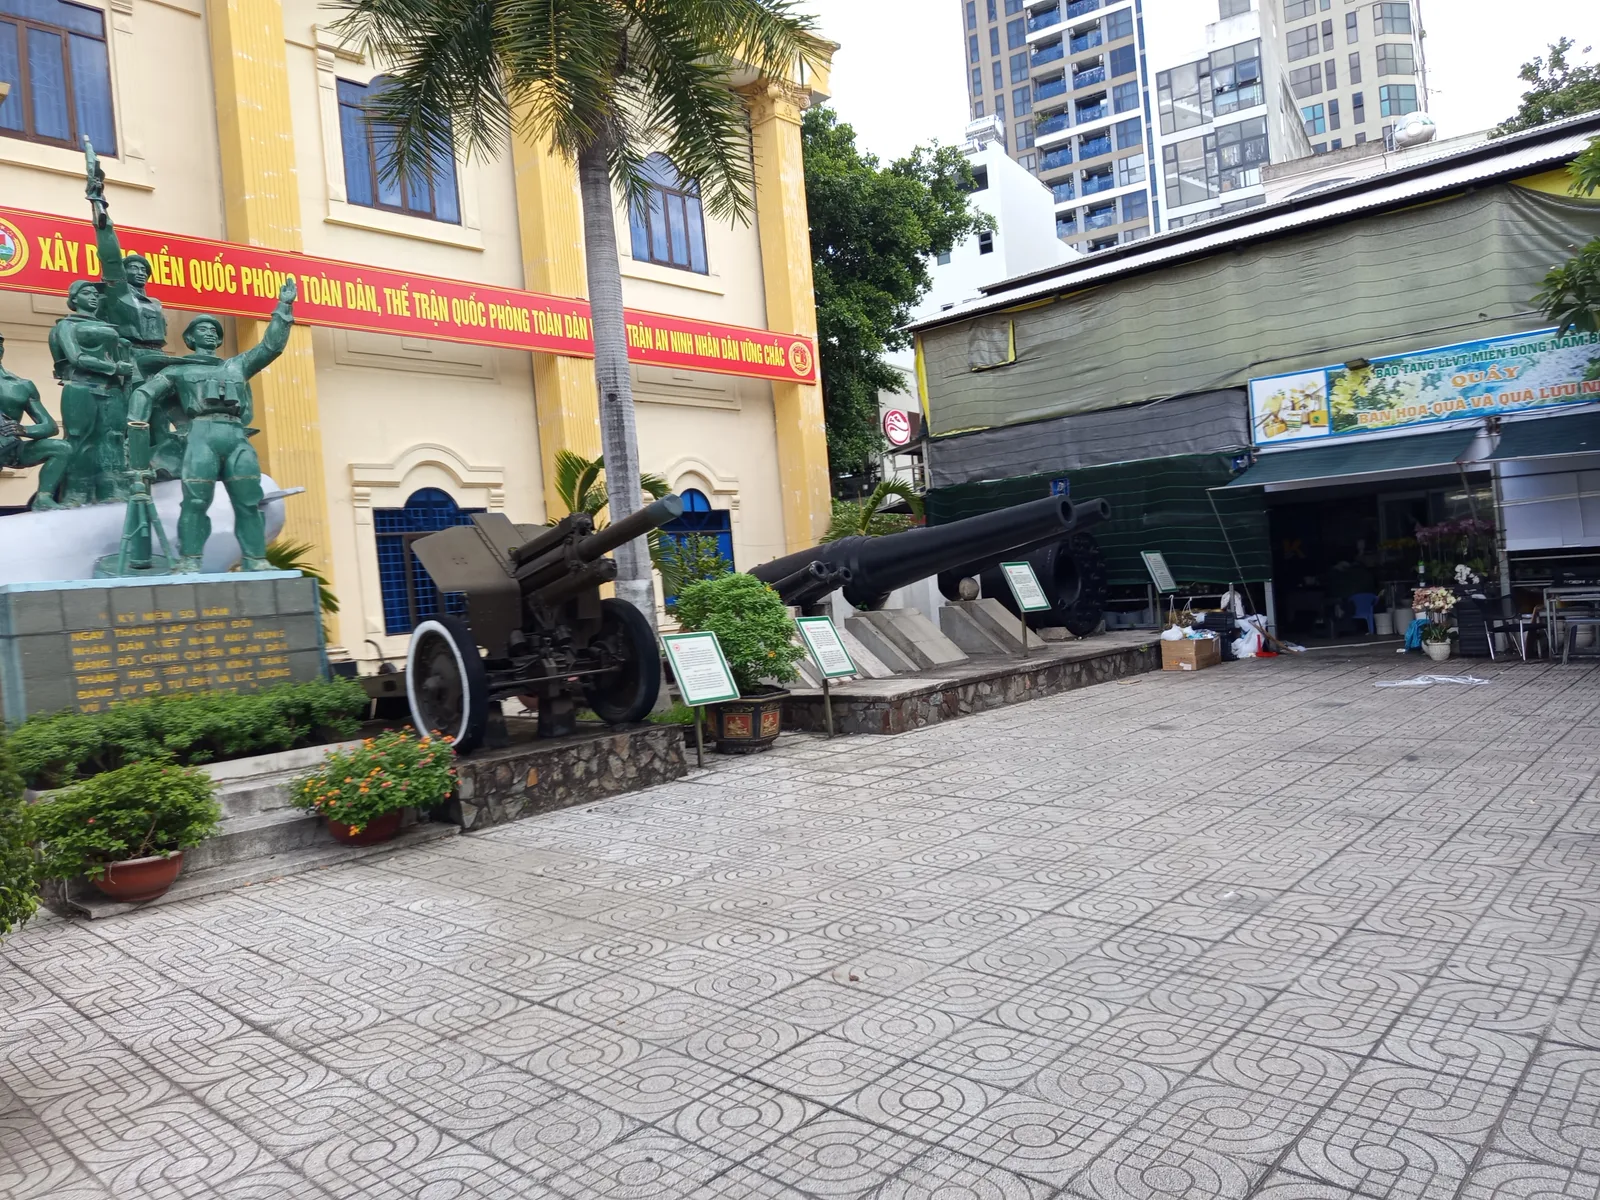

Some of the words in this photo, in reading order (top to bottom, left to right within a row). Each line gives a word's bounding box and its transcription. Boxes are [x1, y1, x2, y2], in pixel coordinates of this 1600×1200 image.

[37, 231, 79, 274] XÂY
[144, 244, 185, 288] NỀN
[189, 252, 237, 294] QUỐC
[300, 271, 343, 308] TOÀN
[345, 277, 382, 316] DÂN,
[383, 282, 411, 317] THẾ
[412, 288, 450, 327] TRẬN
[451, 291, 487, 327] QUỐC
[488, 299, 531, 333] PHÒNG
[531, 306, 563, 337] TOÀN
[564, 311, 589, 341] DÂN
[625, 320, 654, 354] TRẬN
[655, 328, 670, 352] AN
[670, 330, 694, 355] NINH
[694, 331, 720, 359] NHÂN
[721, 334, 740, 361] DÂN
[740, 337, 764, 365] VỮNG
[763, 338, 786, 367] CHẮC
[1437, 353, 1467, 369] LLVT
[1589, 332, 1600, 345] B
[1396, 404, 1428, 419] HOA
